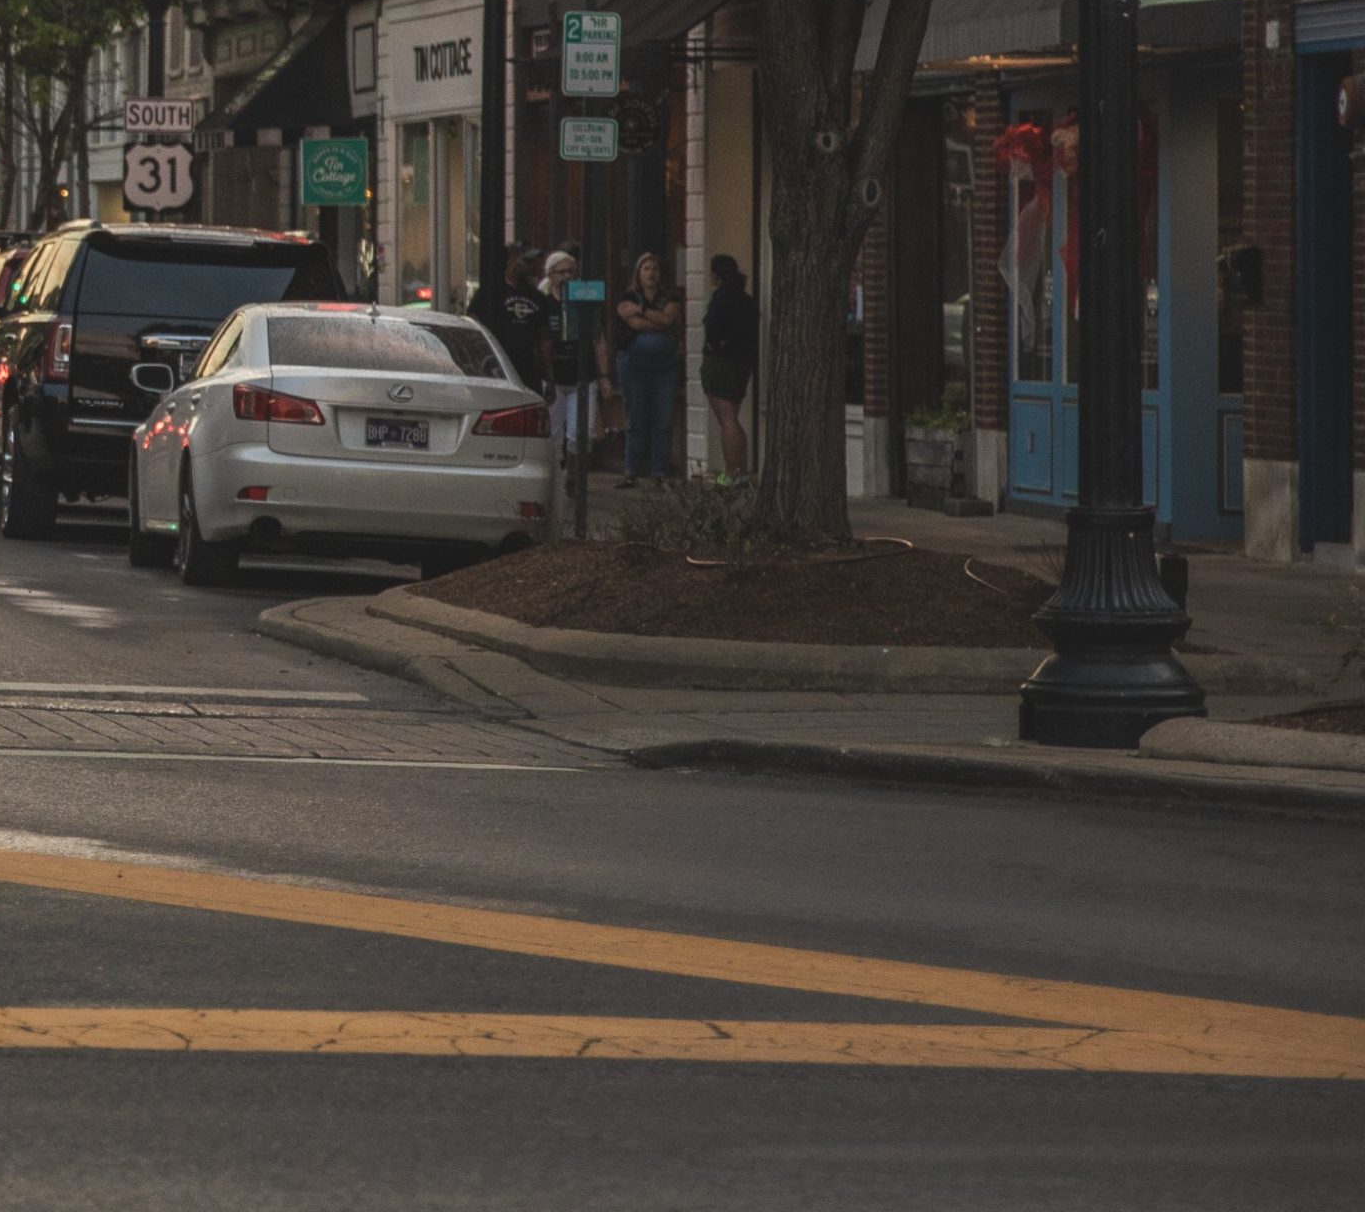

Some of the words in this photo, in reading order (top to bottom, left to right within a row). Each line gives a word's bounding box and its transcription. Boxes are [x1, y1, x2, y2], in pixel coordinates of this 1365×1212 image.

[567, 17, 581, 41] 2
[582, 29, 616, 40] PARKING
[413, 45, 429, 82] TIN
[430, 37, 472, 81] COTTAGE
[596, 52, 609, 63] AM
[569, 69, 579, 80] TO
[581, 69, 600, 80] 5:00
[601, 70, 613, 81] PM
[128, 103, 190, 126] SOUTH
[137, 156, 177, 194] 31
